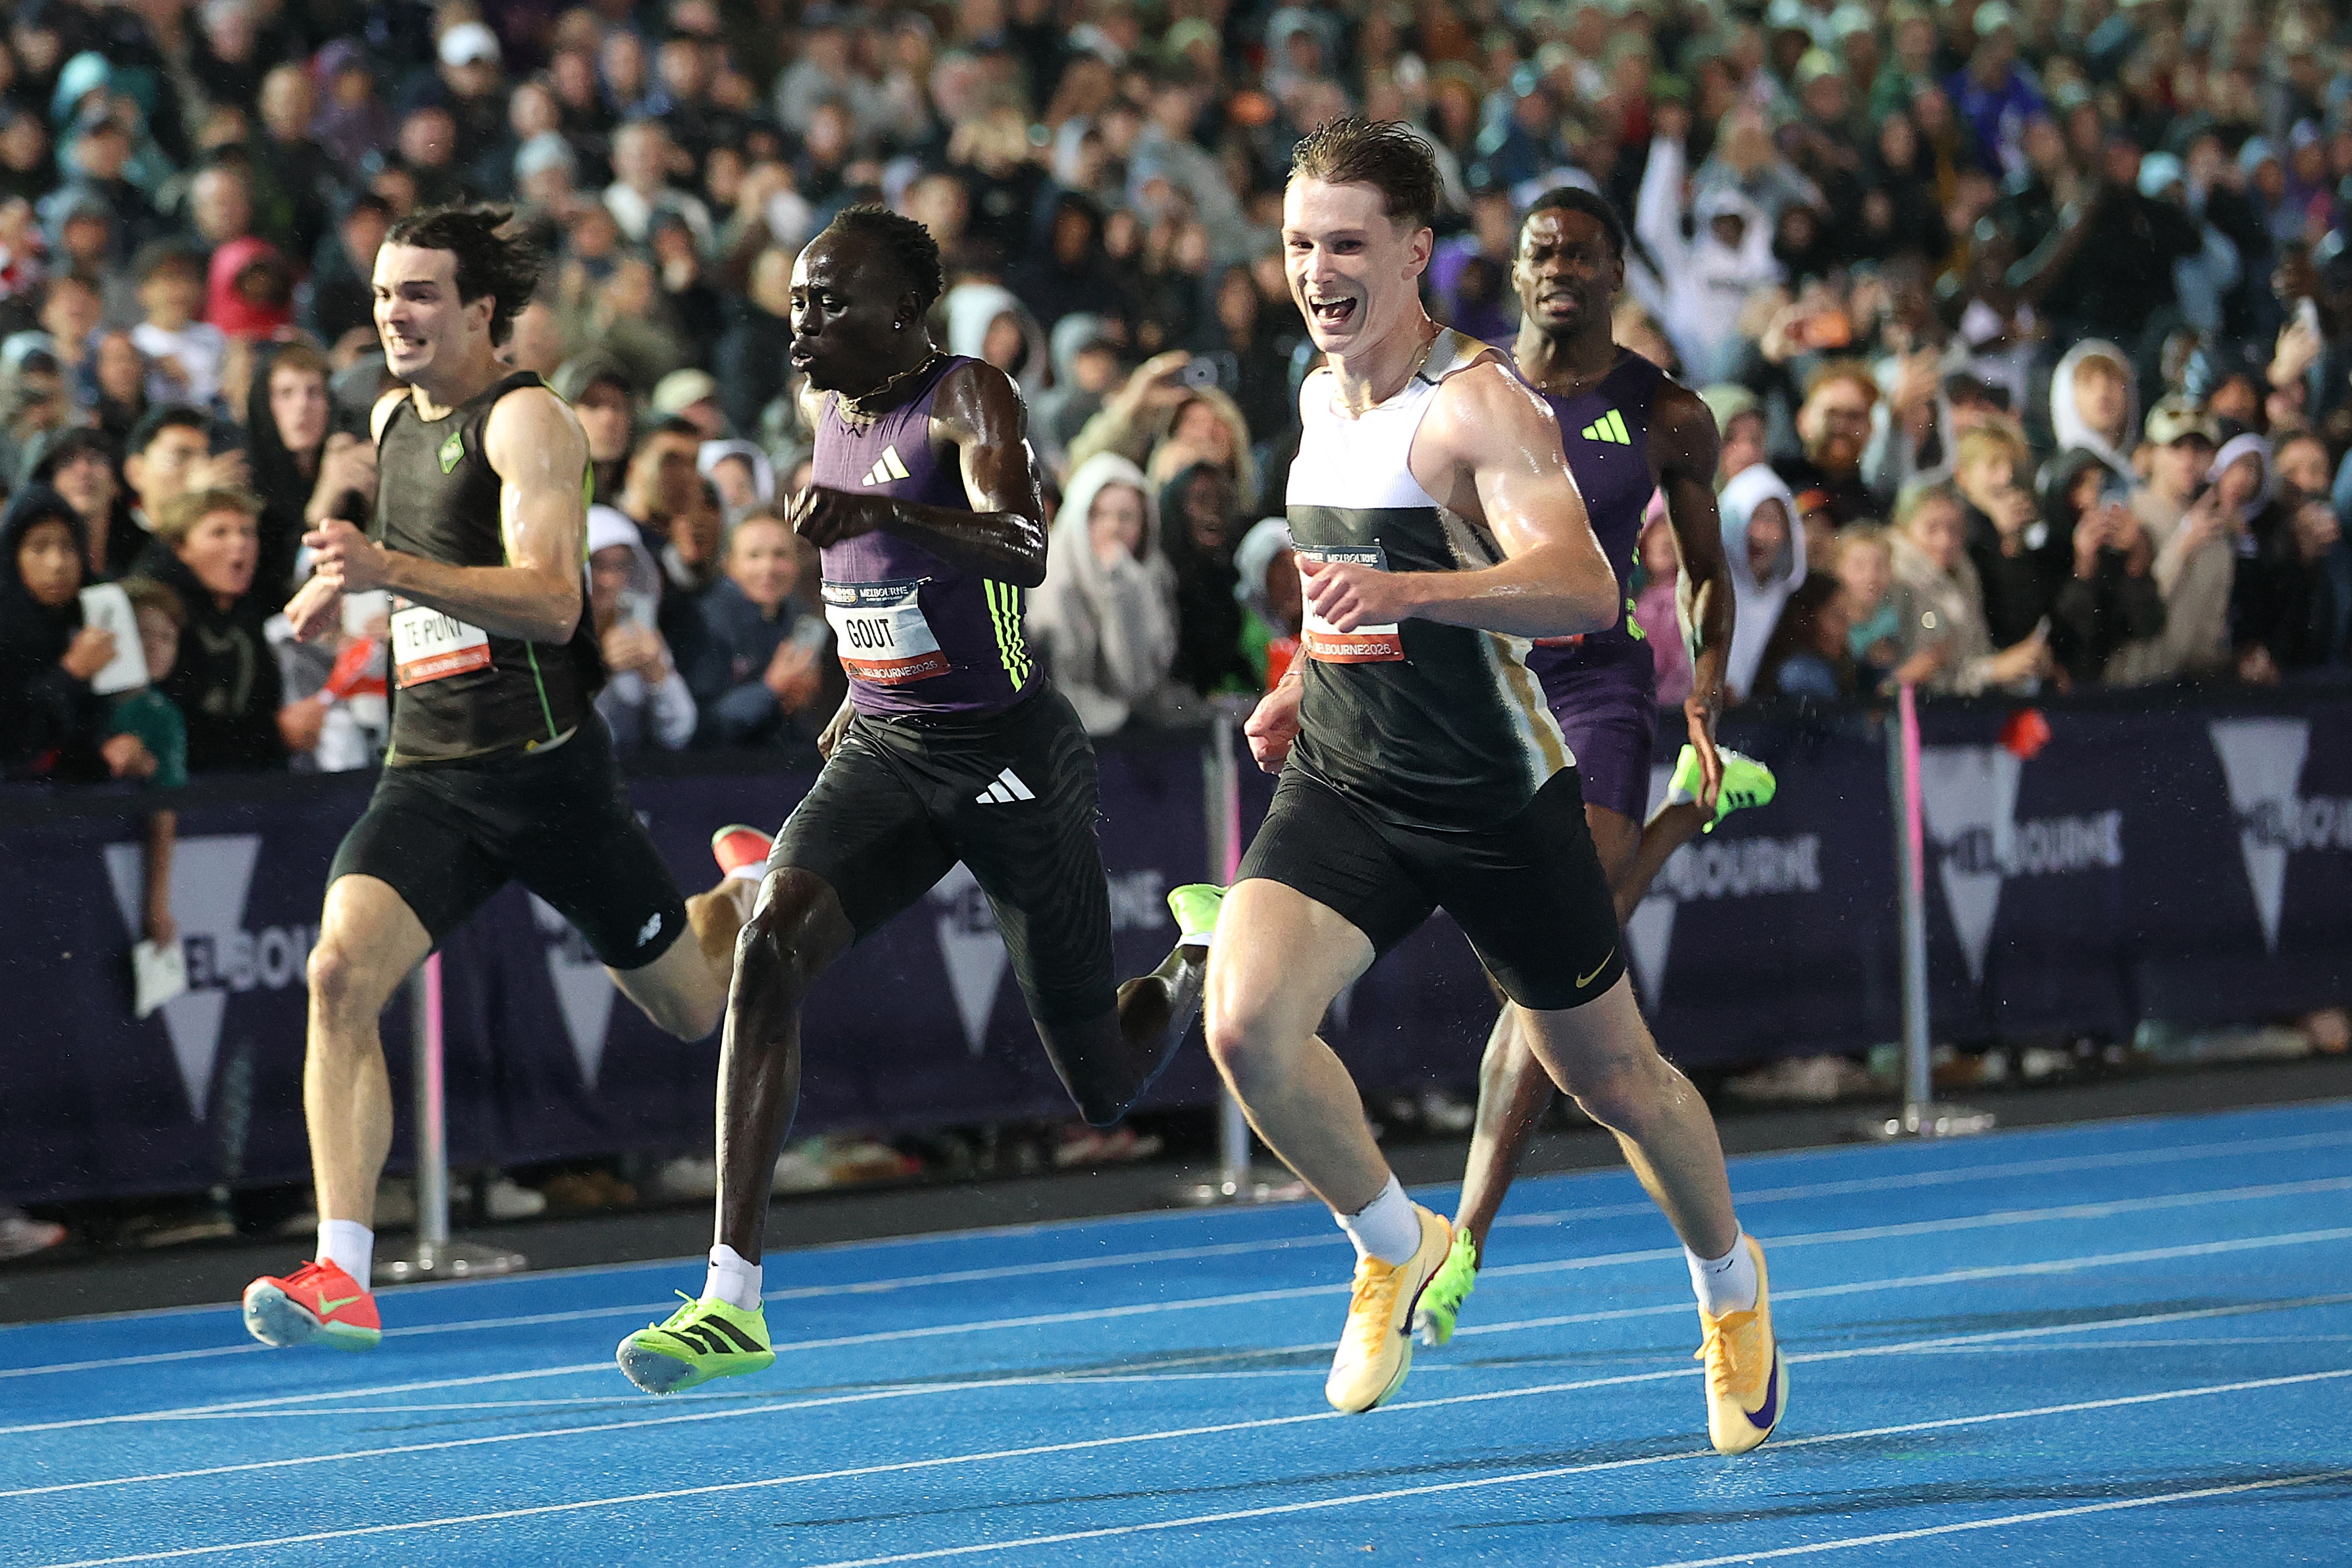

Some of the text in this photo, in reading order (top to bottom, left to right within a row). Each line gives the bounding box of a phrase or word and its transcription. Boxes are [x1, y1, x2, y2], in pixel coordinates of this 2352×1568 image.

[1327, 553, 1378, 564] MELBOURNE
[859, 586, 909, 597] MELBOURNE
[405, 622, 420, 647] TE
[846, 619, 894, 649] GOUT
[1315, 642, 1391, 655] MELBOURNE2026
[859, 660, 938, 678] MELBOURNE2026
